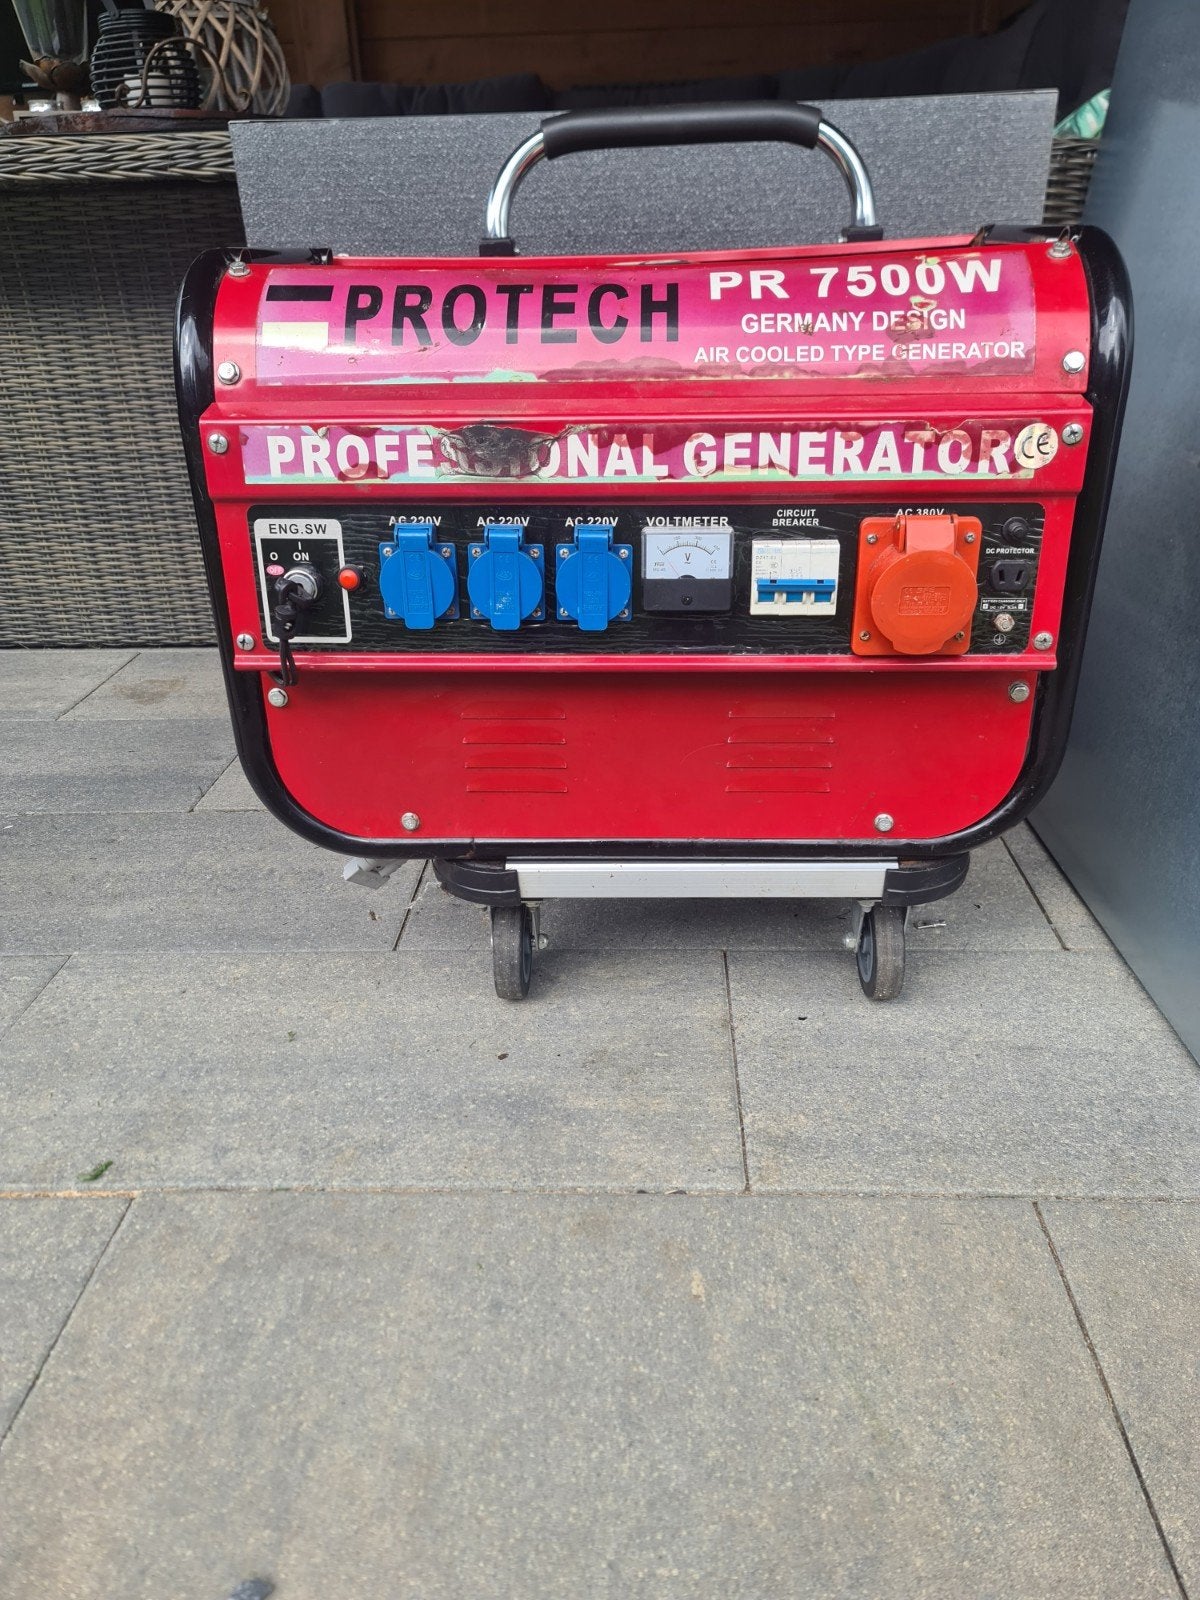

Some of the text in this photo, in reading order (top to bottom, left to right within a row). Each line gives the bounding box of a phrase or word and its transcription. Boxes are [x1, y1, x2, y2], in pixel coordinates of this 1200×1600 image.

[709, 258, 1002, 300] PR 7500W
[344, 283, 680, 347] PROTECH
[741, 308, 965, 334] GERMANY DESIGN
[694, 340, 1026, 364] AIR COOLED TYPE GENERATOR
[683, 430, 1016, 477] GENERATOR
[776, 509, 817, 518] CIRCUIT
[646, 516, 729, 527] VOLTMETER
[772, 518, 820, 527] BREAKER
[268, 523, 328, 535] ENG.SW
[292, 551, 310, 561] ON
[985, 547, 1035, 555] DC PROTECTOR
